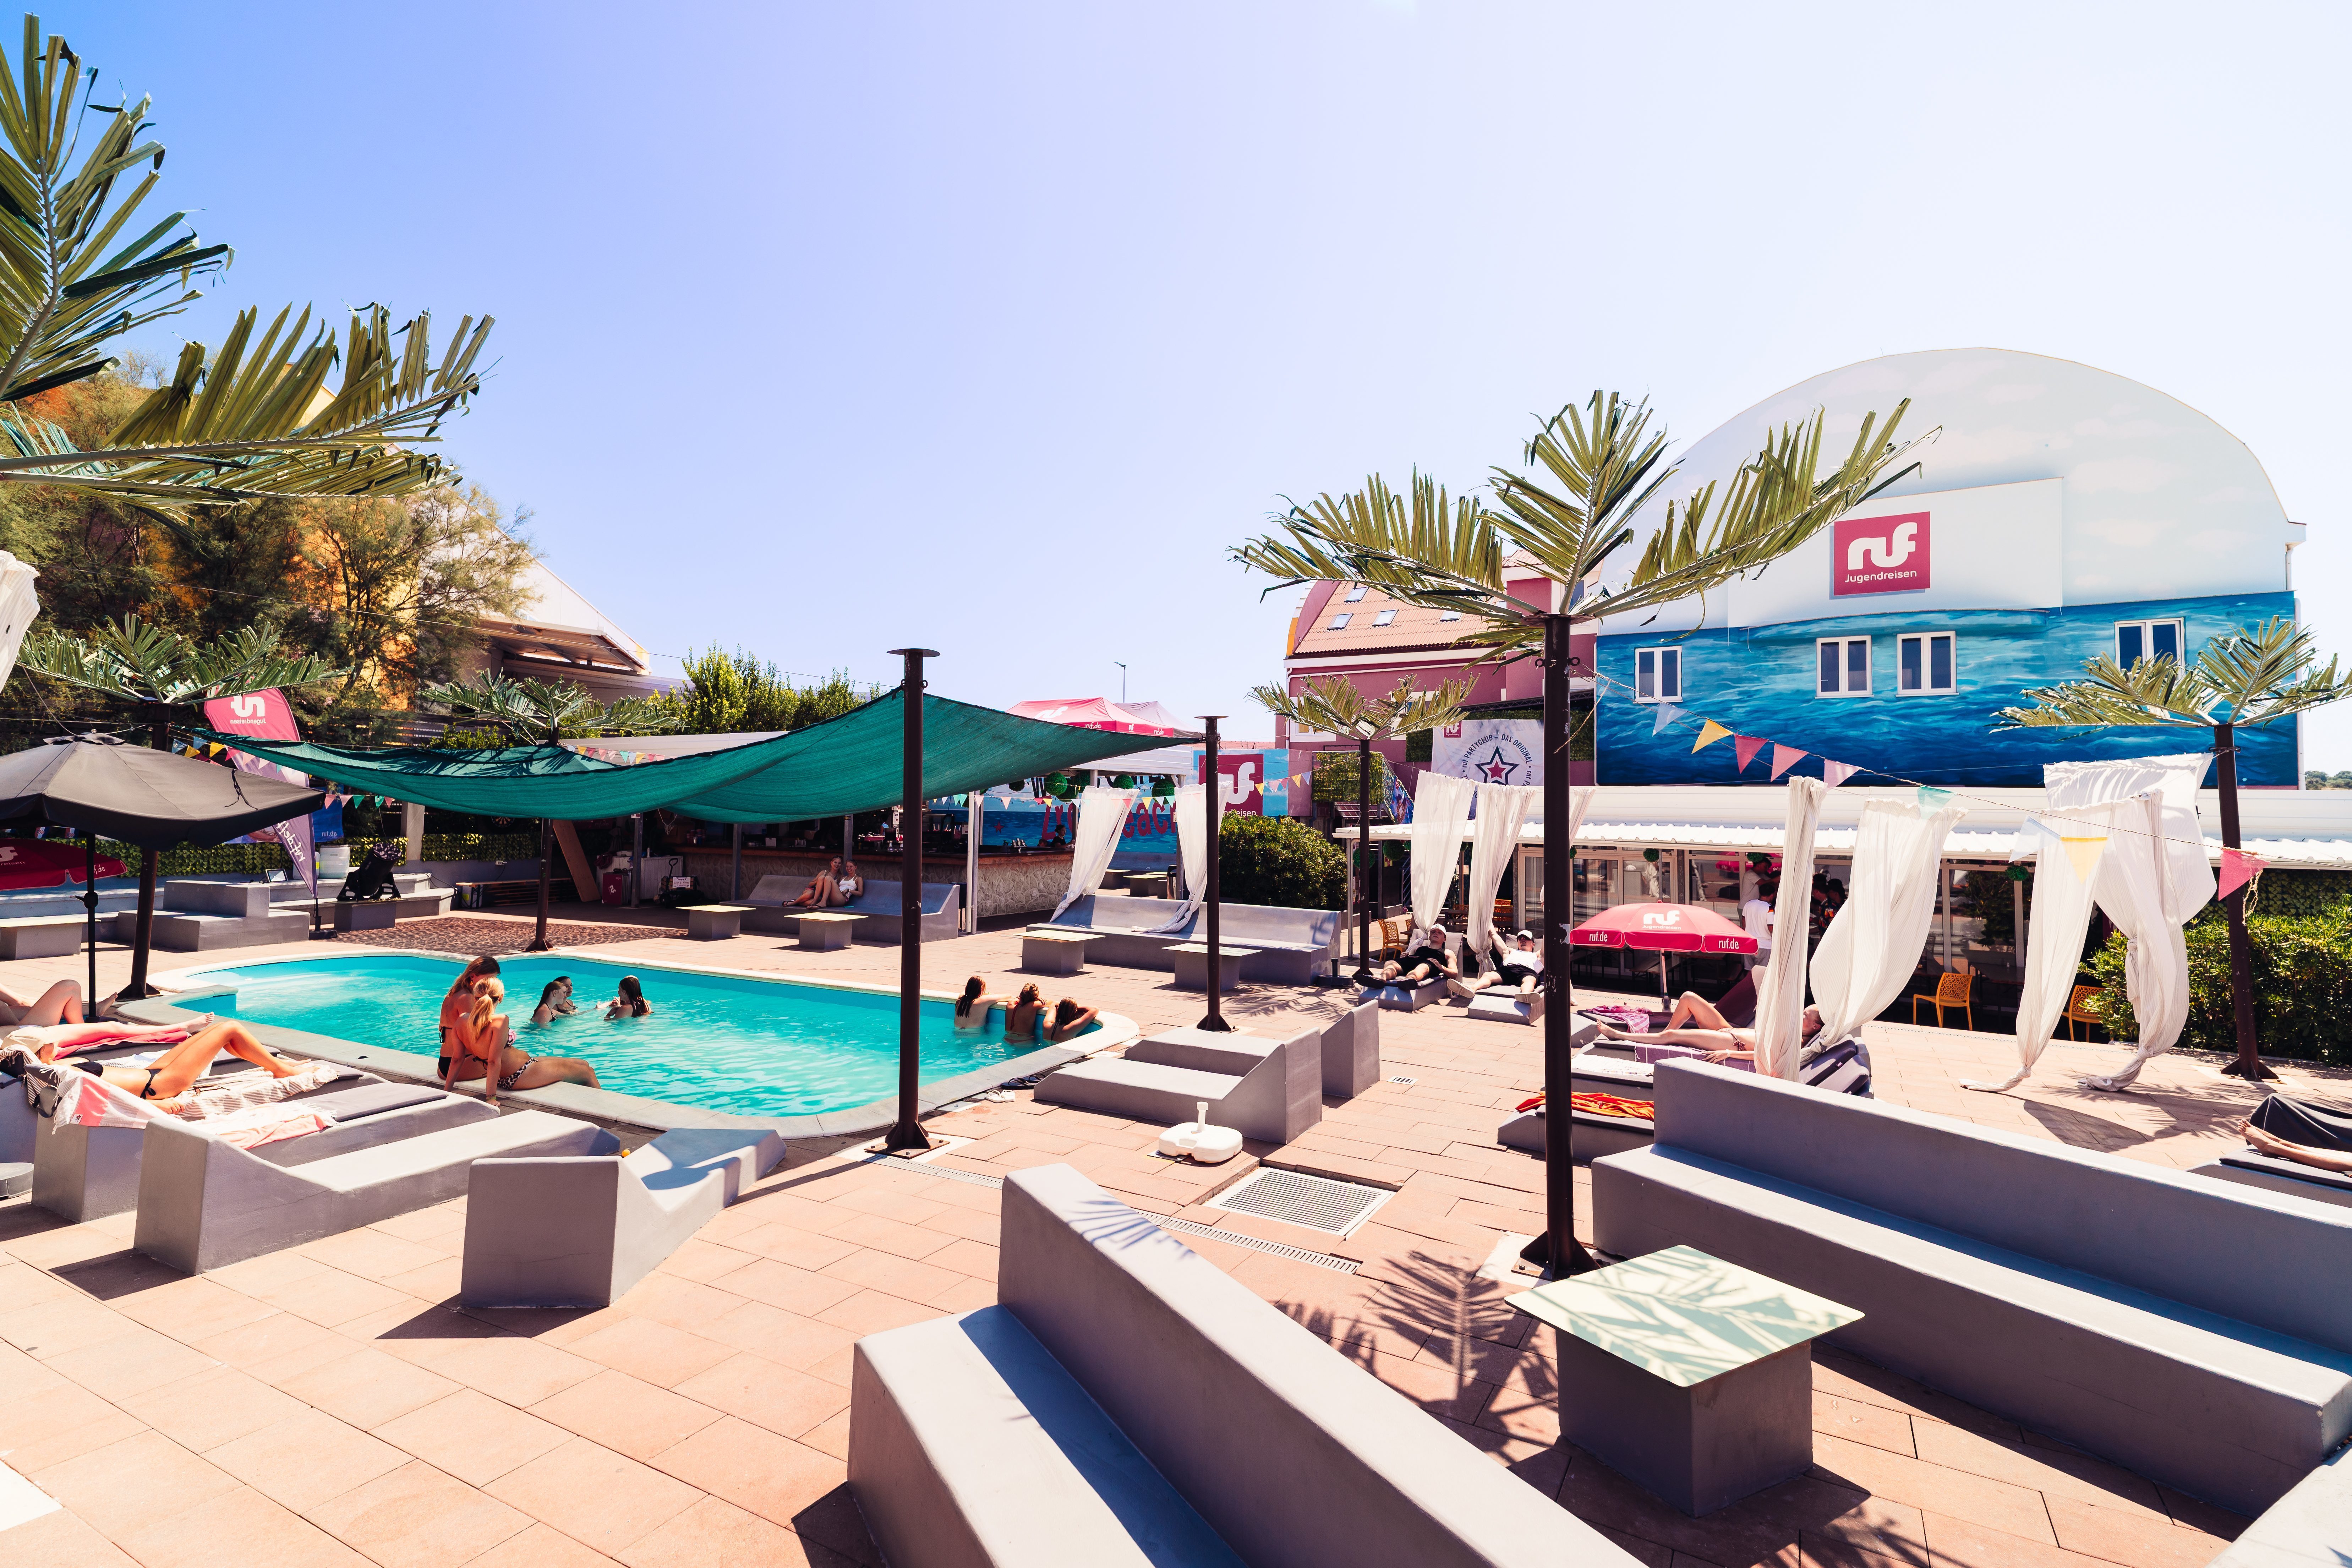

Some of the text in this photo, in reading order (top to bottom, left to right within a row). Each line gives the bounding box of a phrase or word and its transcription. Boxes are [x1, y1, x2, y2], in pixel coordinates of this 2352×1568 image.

[1848, 522, 1917, 570] ruf
[1845, 570, 1917, 584] Jugendreisen
[1034, 706, 1068, 719] ruf
[1446, 722, 1459, 733] ruf
[1464, 734, 1493, 759] PARTYCLUB
[1501, 733, 1513, 743] DAS
[1513, 739, 1533, 764] ORIGINAL
[1643, 910, 1680, 925] ruf
[1589, 931, 1608, 942] ruf.de
[1718, 938, 1739, 950] ruf.de
